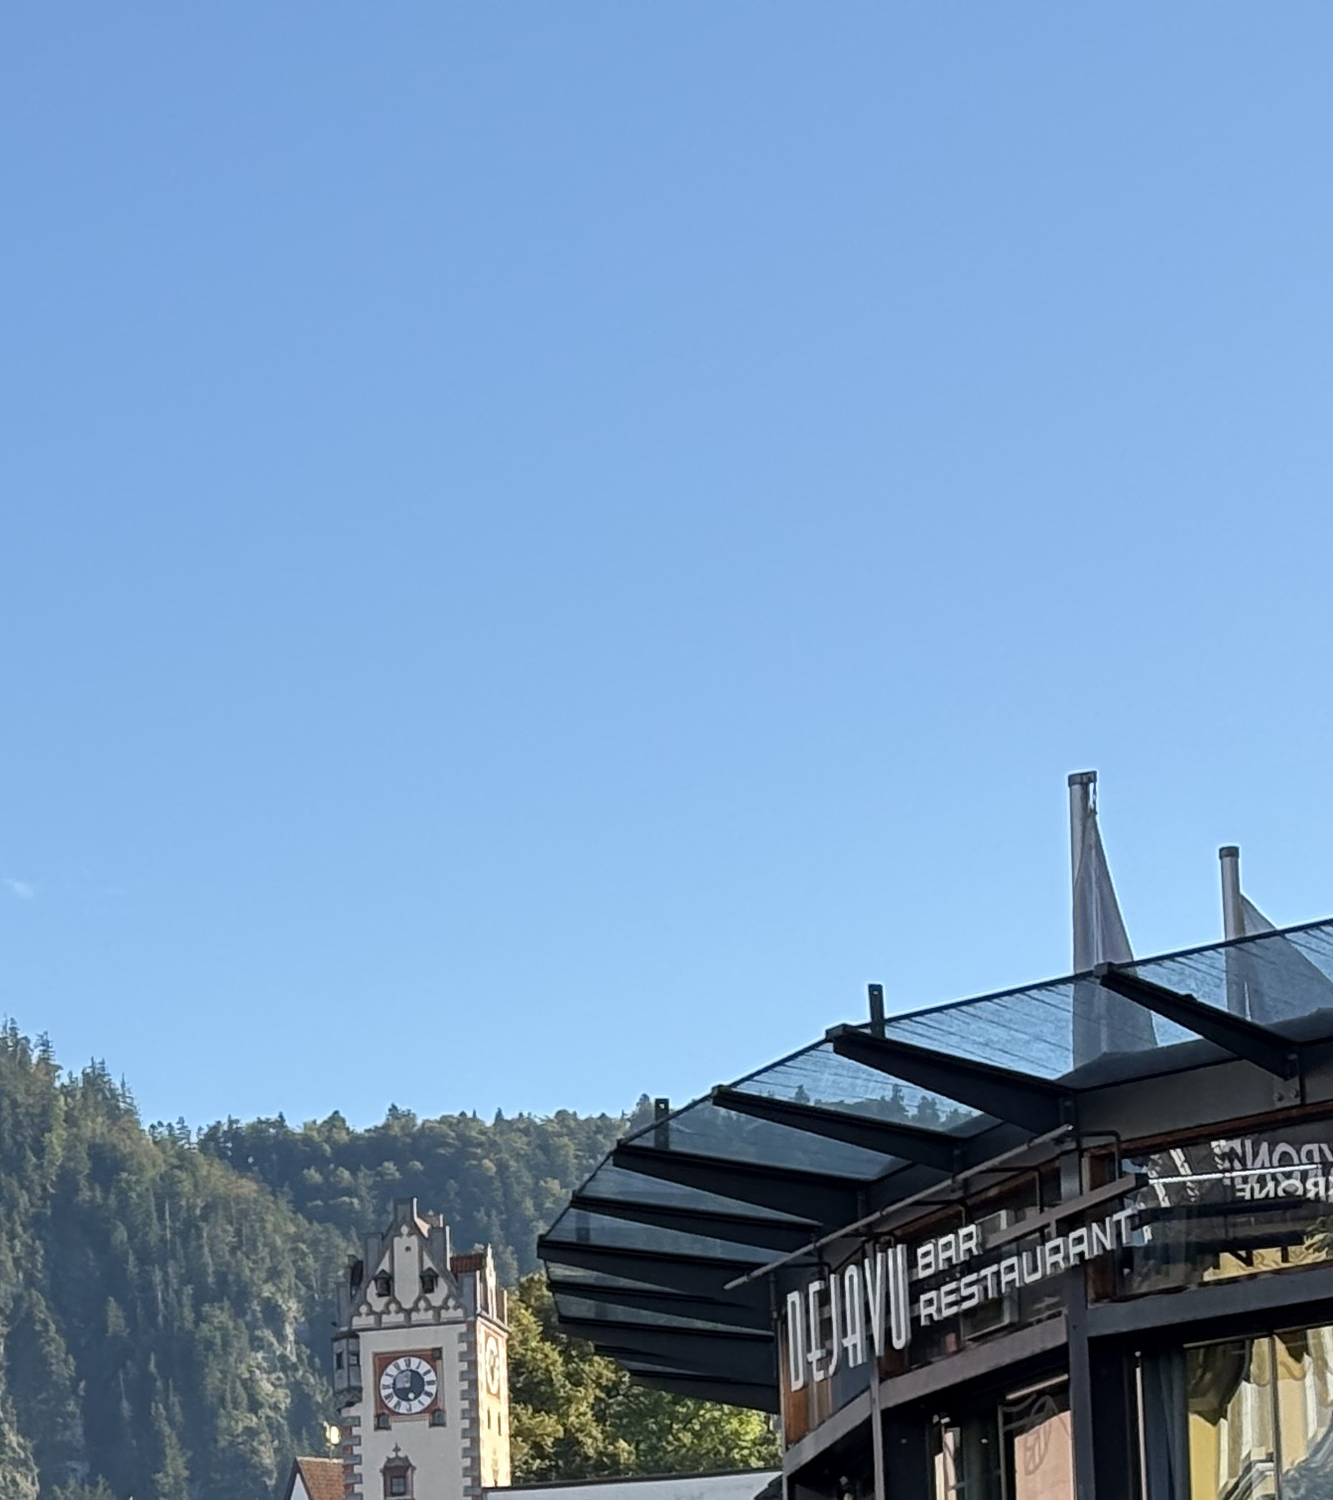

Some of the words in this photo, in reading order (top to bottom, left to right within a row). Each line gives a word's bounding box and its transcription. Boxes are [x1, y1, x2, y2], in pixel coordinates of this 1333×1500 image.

[917, 1224, 980, 1280] BAR
[920, 1207, 1139, 1327] RESTAURANT
[787, 1244, 911, 1392] DEJAVU
